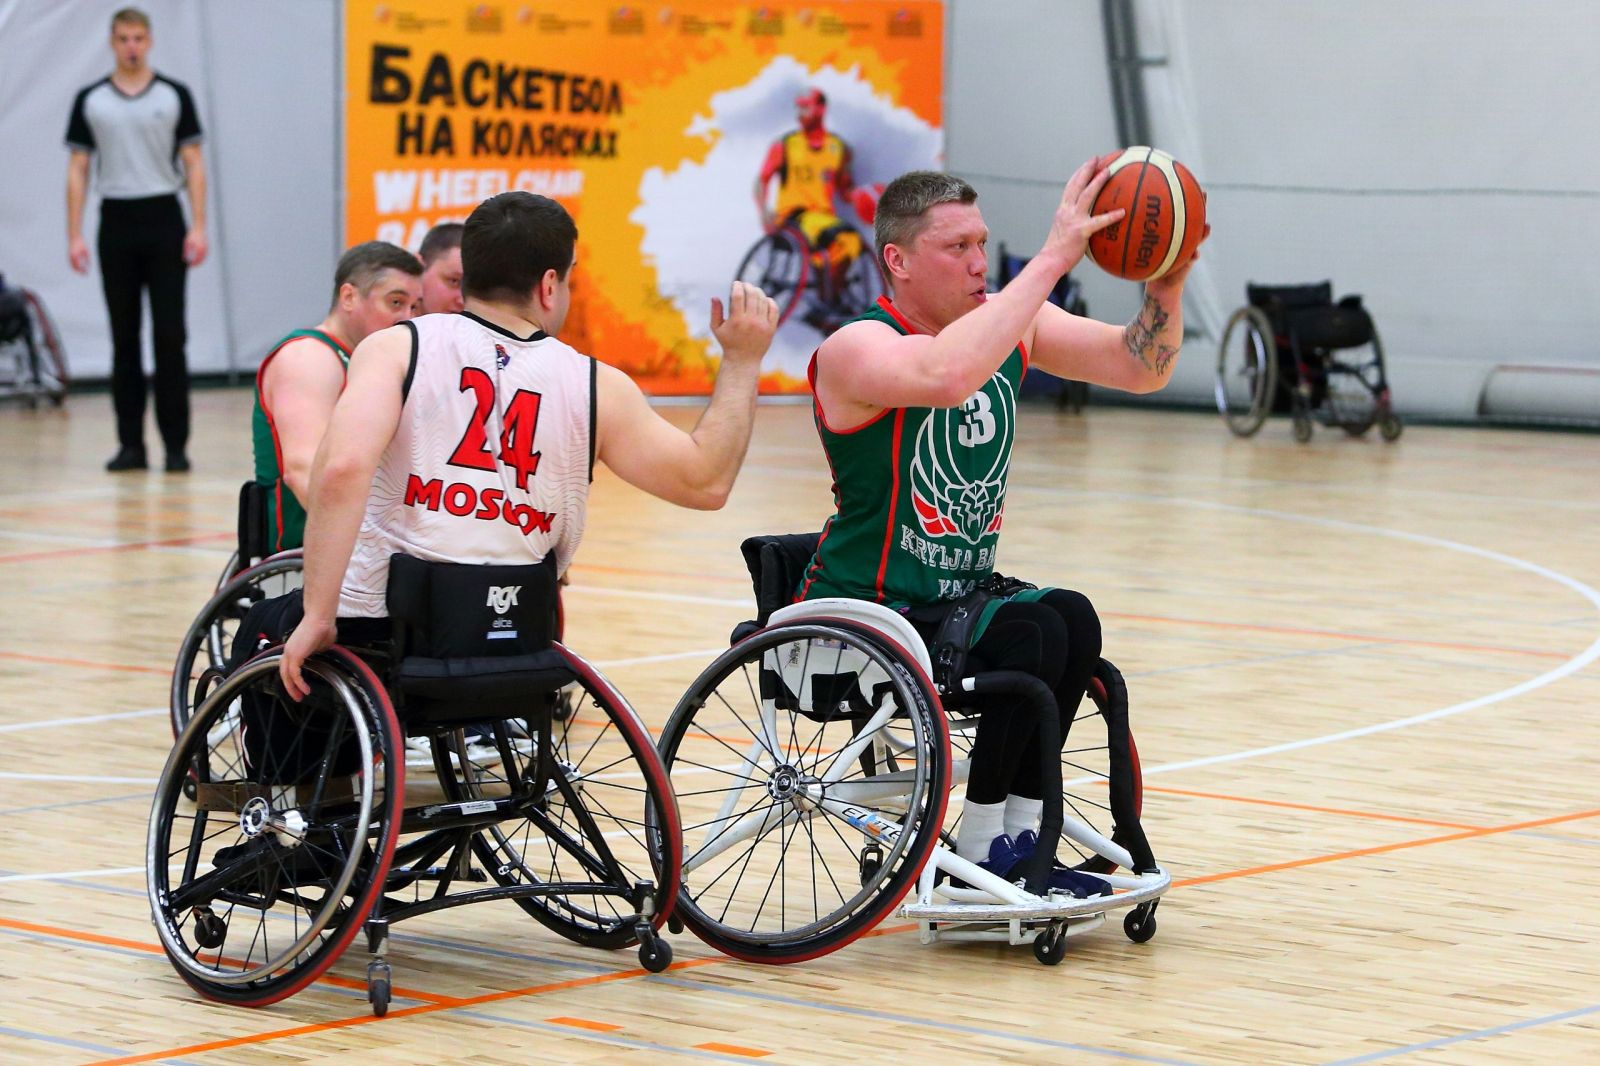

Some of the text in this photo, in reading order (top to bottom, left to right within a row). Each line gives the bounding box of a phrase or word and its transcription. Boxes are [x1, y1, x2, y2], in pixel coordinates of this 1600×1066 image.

[369, 43, 624, 115] БАСКЕТБОЛ
[397, 111, 617, 158] НА КОЛЯСКАХ
[1134, 194, 1161, 269] molten
[446, 366, 542, 494] 24
[404, 473, 556, 536] MOSCOW
[901, 524, 973, 570] KRYLJA
[486, 586, 522, 614] RGK
